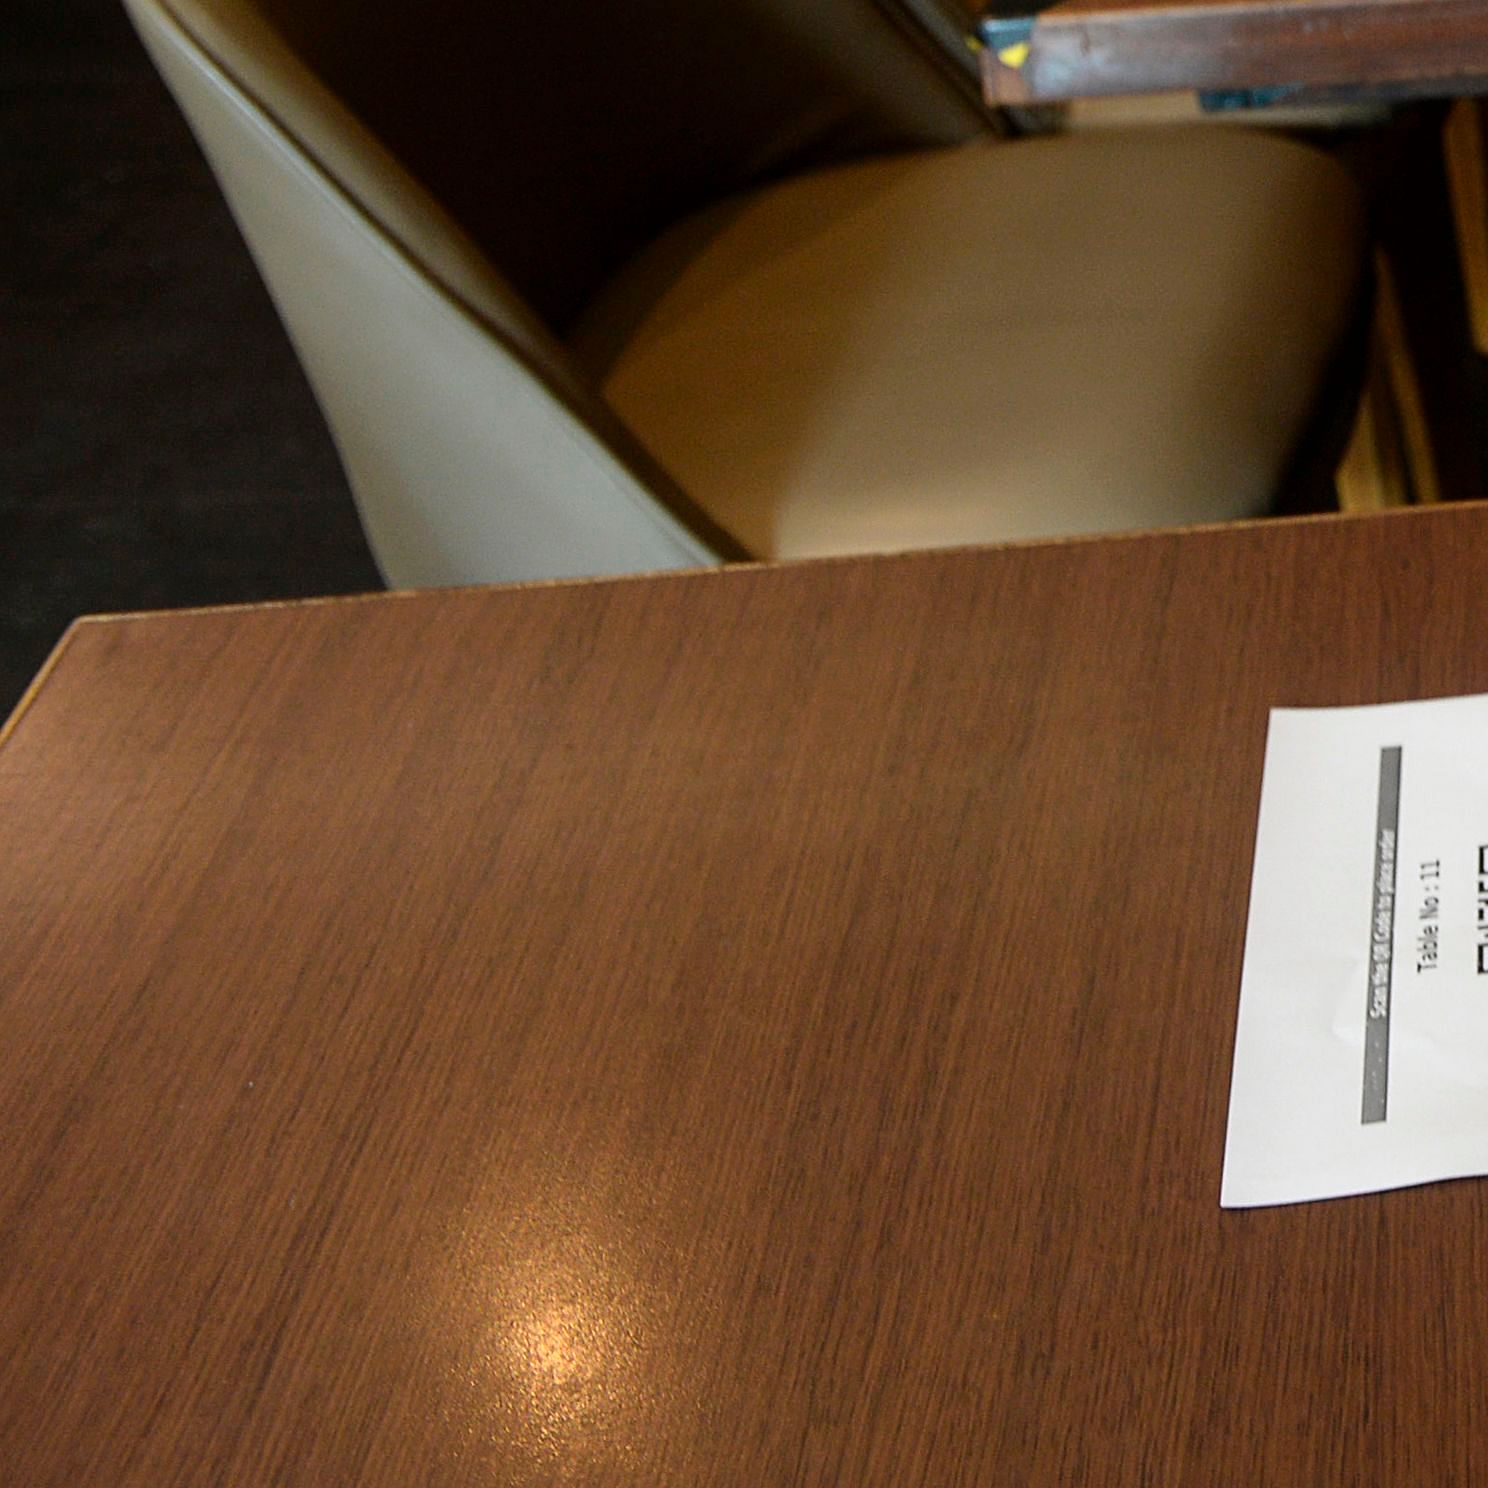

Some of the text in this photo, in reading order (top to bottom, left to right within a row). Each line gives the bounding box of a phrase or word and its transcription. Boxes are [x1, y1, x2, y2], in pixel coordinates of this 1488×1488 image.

[1419, 860, 1440, 880] 11
[1370, 829, 1396, 1018] Scan the QR Code to place order
[1416, 925, 1439, 973] Table
